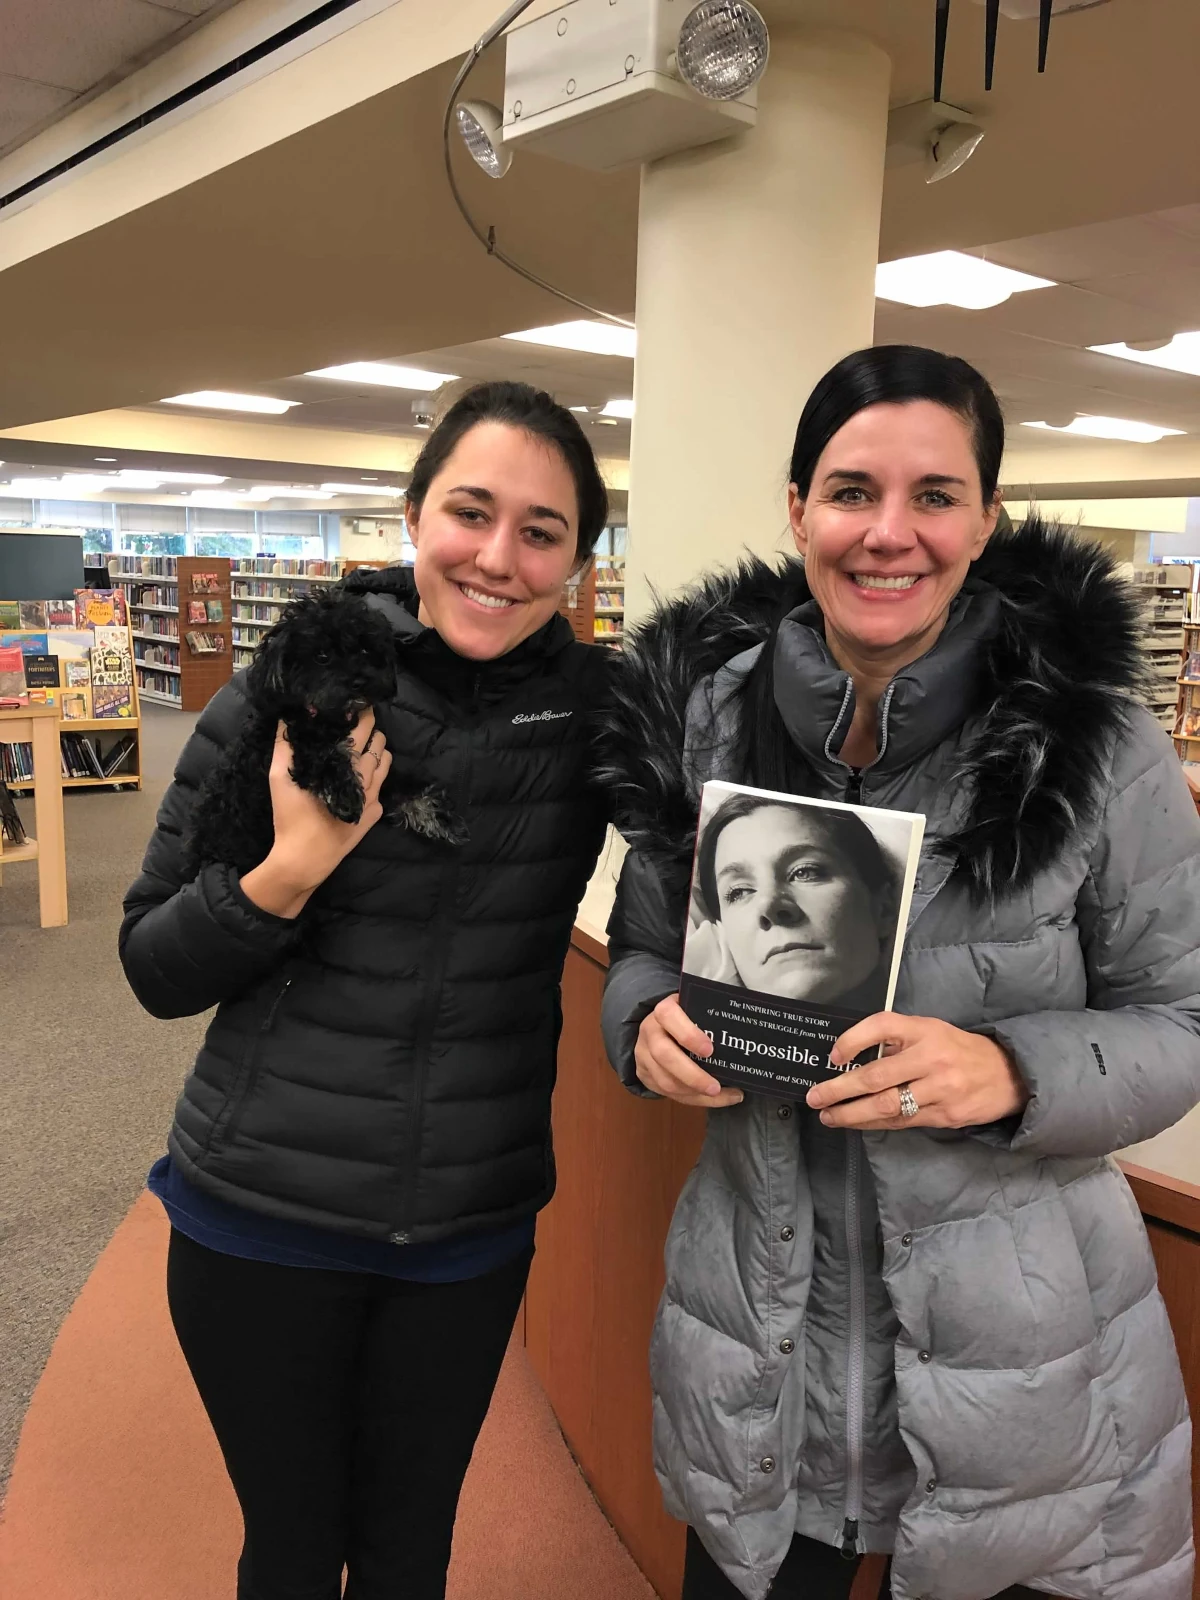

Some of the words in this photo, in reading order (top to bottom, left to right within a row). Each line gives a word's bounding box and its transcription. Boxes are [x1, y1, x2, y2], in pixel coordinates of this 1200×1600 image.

[706, 1008, 715, 1016] of
[721, 1011, 758, 1026] WOMAN'S
[758, 1020, 799, 1035] STRUGGLE
[799, 1029, 816, 1039] from
[729, 999, 742, 1009] The
[742, 1002, 781, 1017] INSPIRING
[783, 1012, 804, 1022] TRUE
[804, 1016, 831, 1027] STORY
[720, 1030, 820, 1067] Impossible
[729, 1062, 775, 1079] SIDDOWAY
[776, 1073, 791, 1082] and
